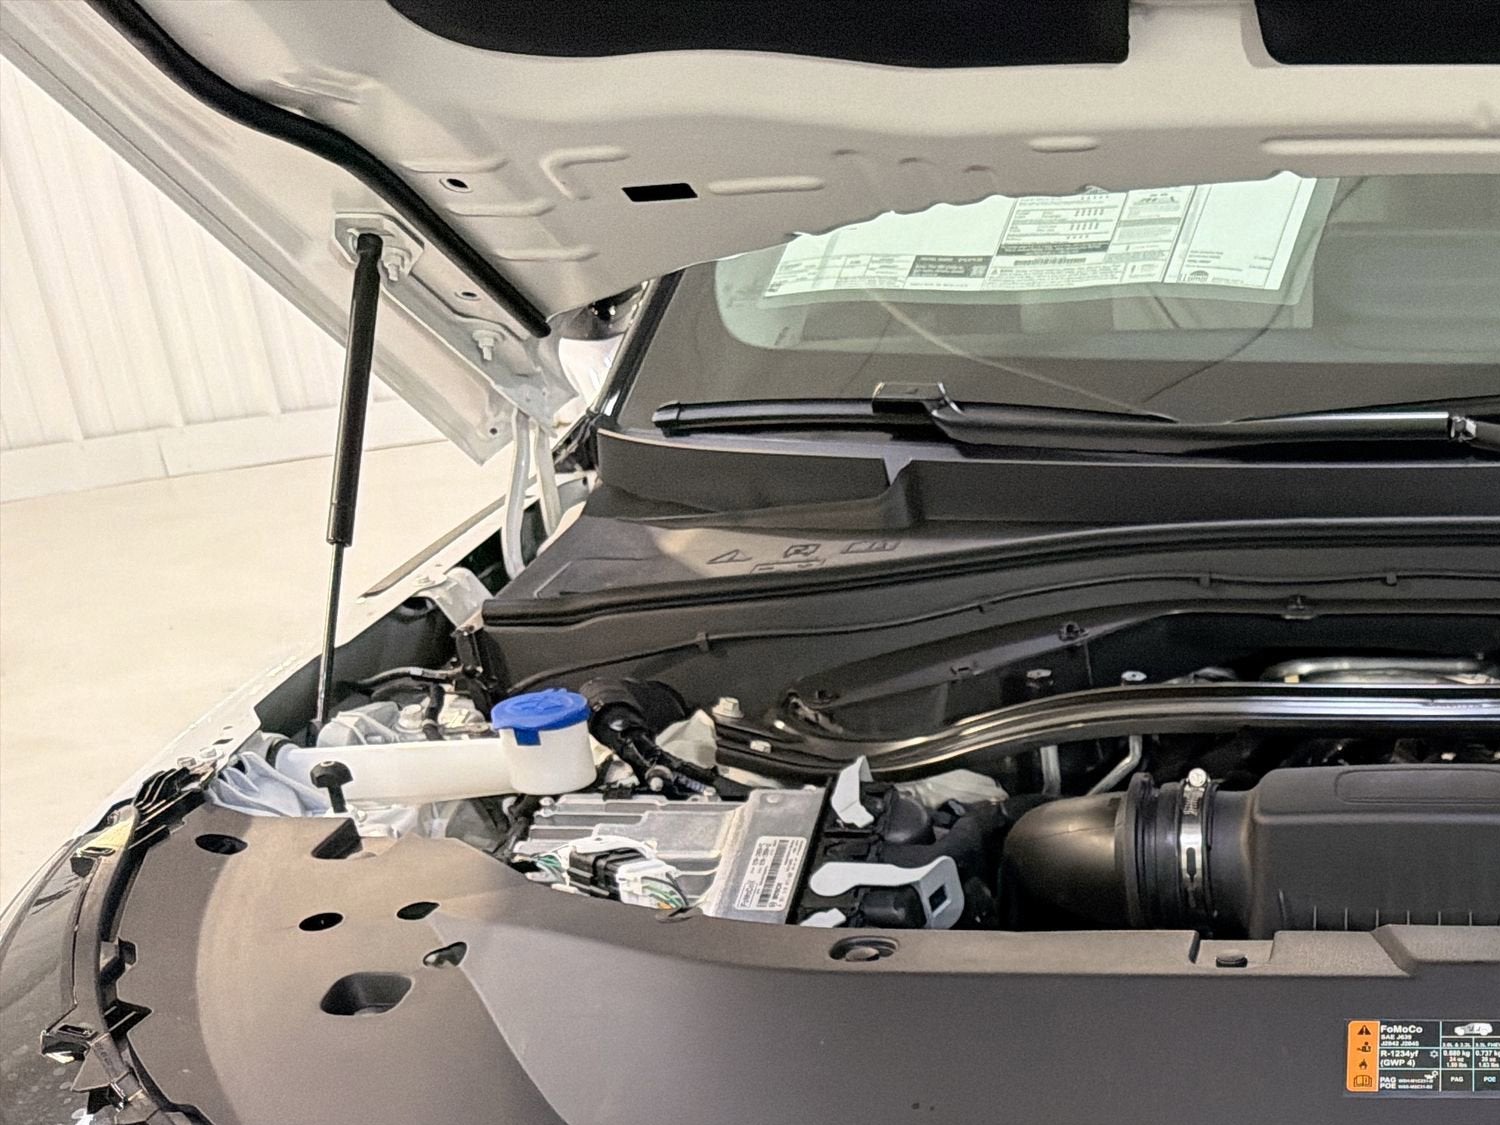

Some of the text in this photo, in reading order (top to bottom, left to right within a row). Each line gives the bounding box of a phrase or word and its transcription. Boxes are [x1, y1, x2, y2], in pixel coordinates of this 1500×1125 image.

[1380, 1025, 1423, 1033] FoMoCo
[1380, 1049, 1419, 1059] R-1234yf
[1461, 1050, 1471, 1058] kg
[1380, 1059, 1416, 1067] (GWP 4)
